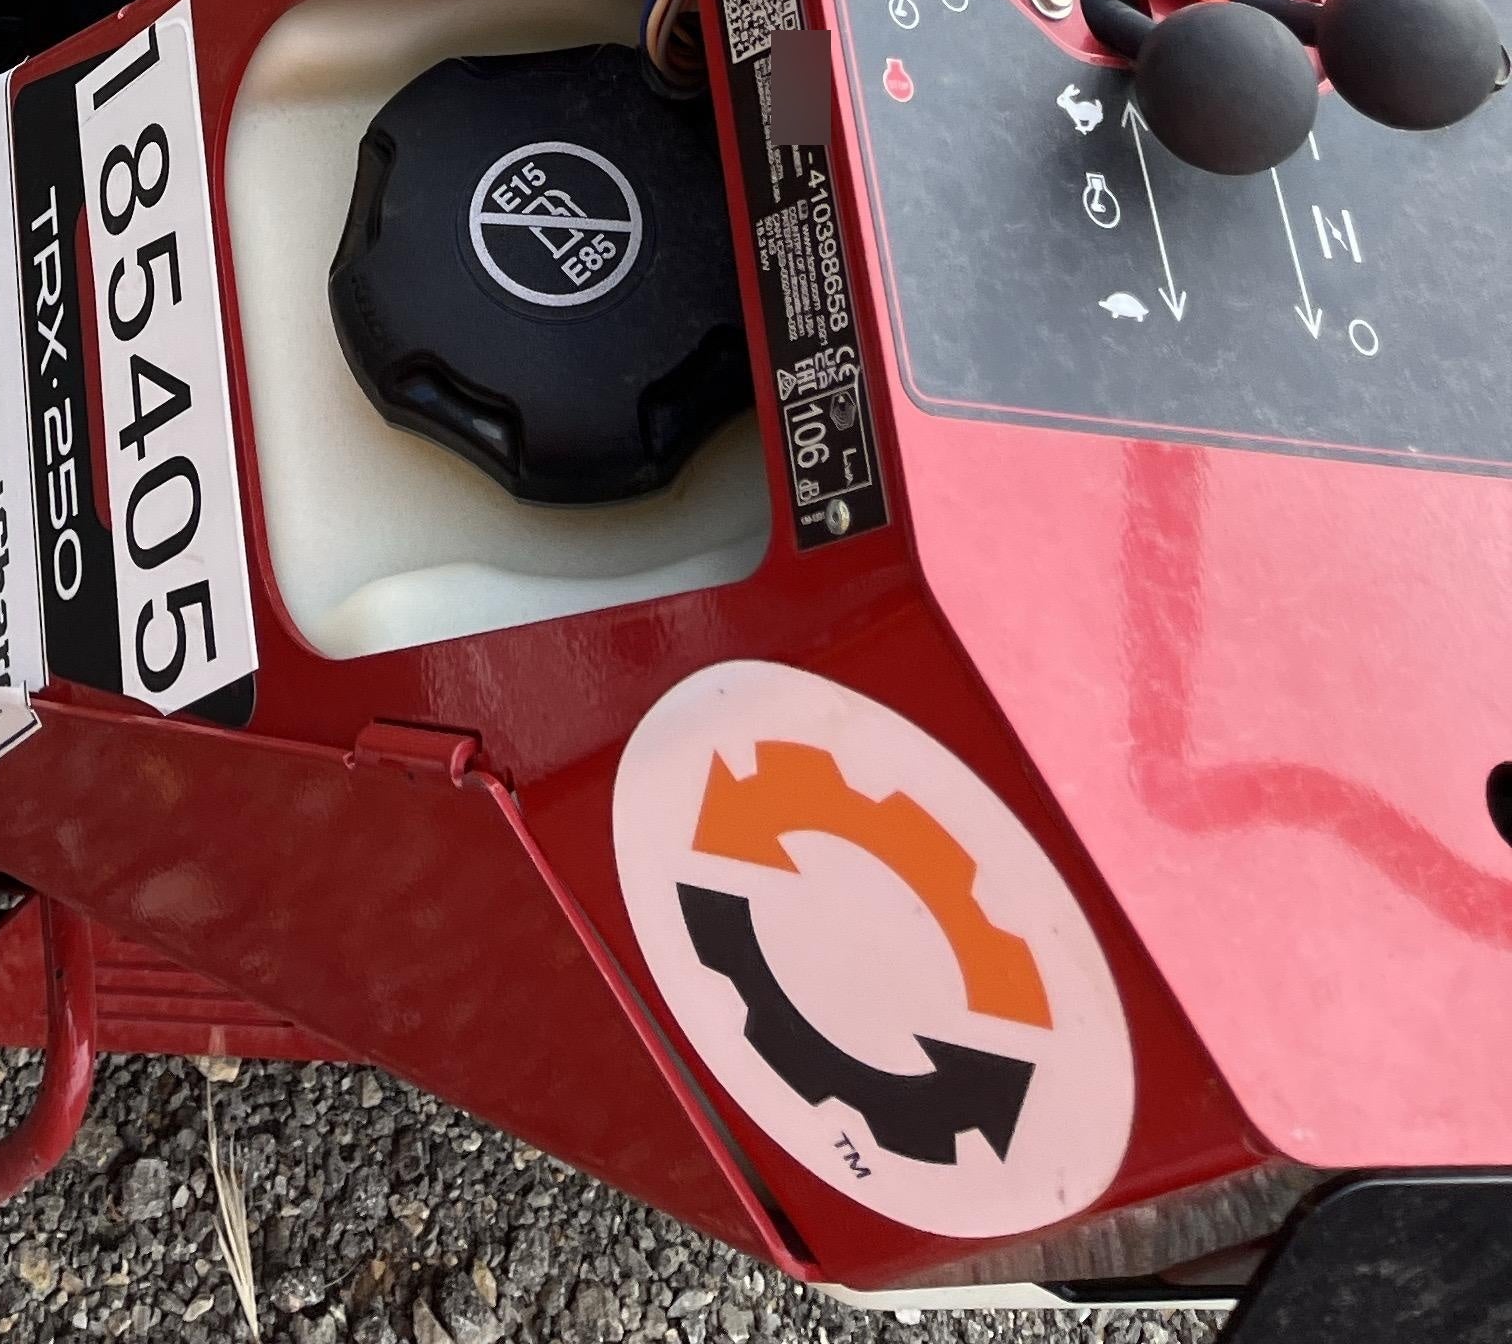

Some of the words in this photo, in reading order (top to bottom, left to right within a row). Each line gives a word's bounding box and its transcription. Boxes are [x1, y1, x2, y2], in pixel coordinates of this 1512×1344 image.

[491, 161, 547, 213] E15
[560, 233, 617, 286] E85
[92, 23, 216, 693] 185405
[836, 346, 855, 381] CE
[791, 403, 830, 469] 106
[798, 479, 820, 502] dB
[832, 1132, 871, 1180] TM
